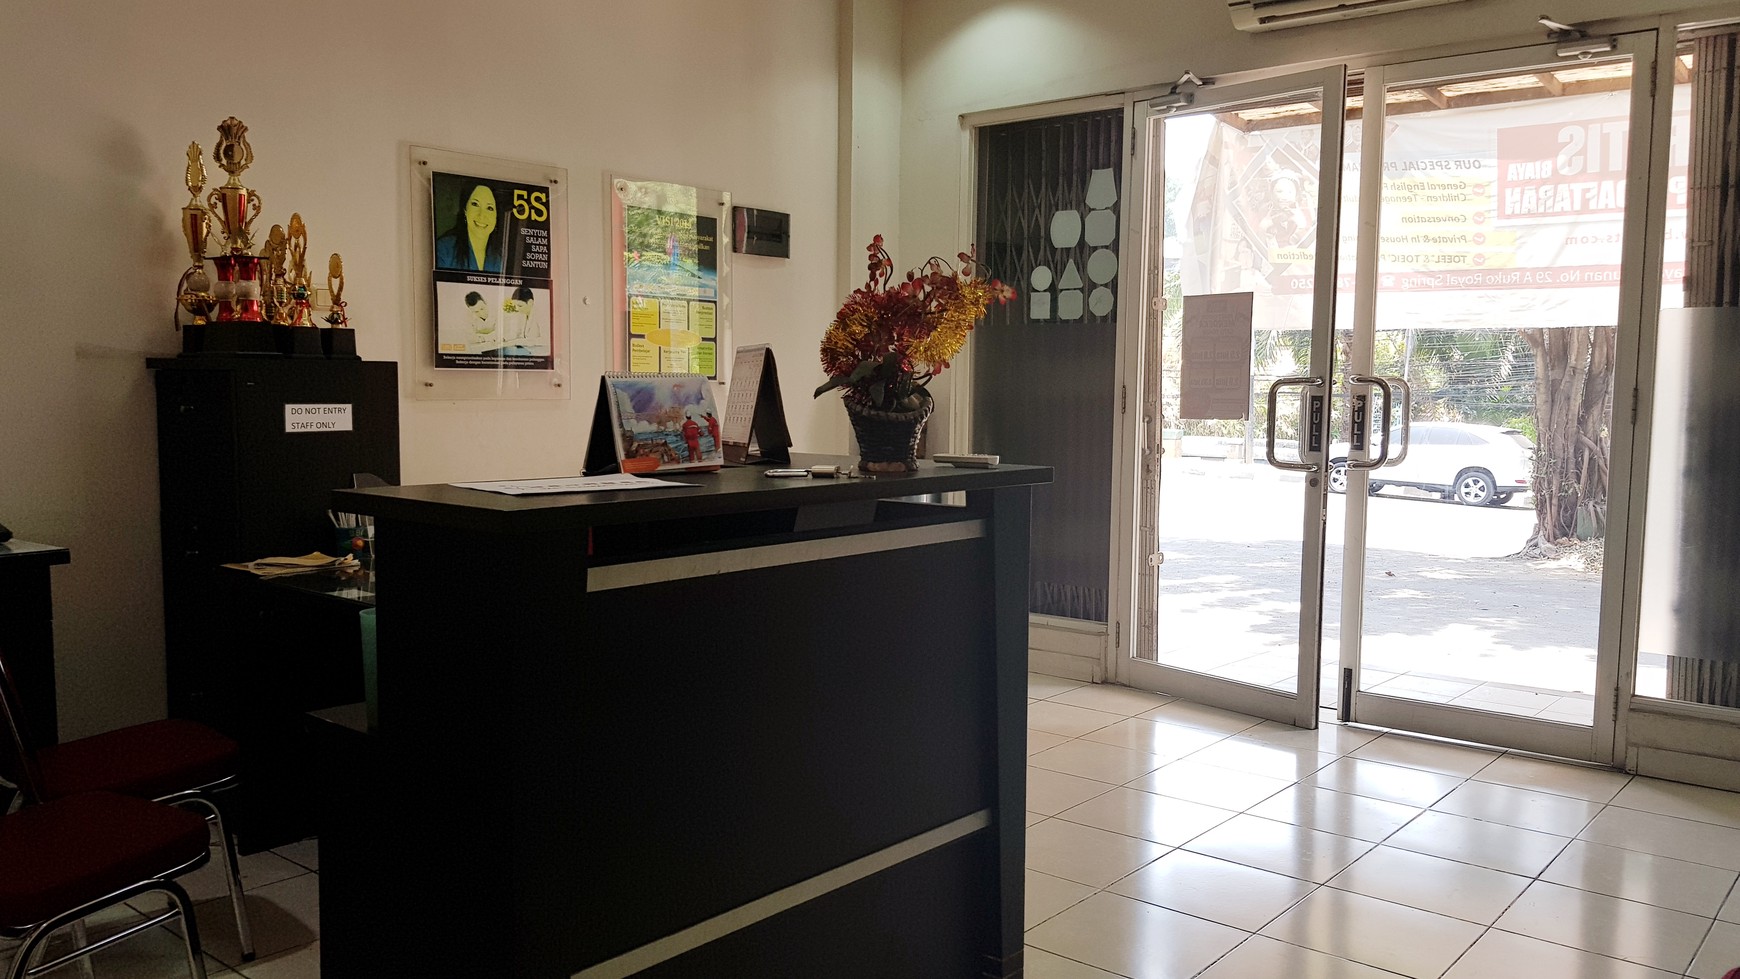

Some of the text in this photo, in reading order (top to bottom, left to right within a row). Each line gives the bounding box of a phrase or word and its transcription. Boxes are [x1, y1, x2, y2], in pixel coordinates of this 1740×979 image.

[512, 189, 549, 223] 5S
[520, 227, 548, 238] SENYUM
[525, 236, 548, 246] SALAM
[531, 245, 548, 254] SAPA
[525, 252, 548, 262] SOPAN
[522, 260, 548, 270] SANTUN
[466, 275, 523, 286] SUKSES PELANGGAN
[291, 406, 347, 415] DO NOT ENTRY
[291, 421, 336, 430] STAFF ONLY
[1312, 400, 1321, 447] PULL
[1353, 400, 1363, 446] PULL
